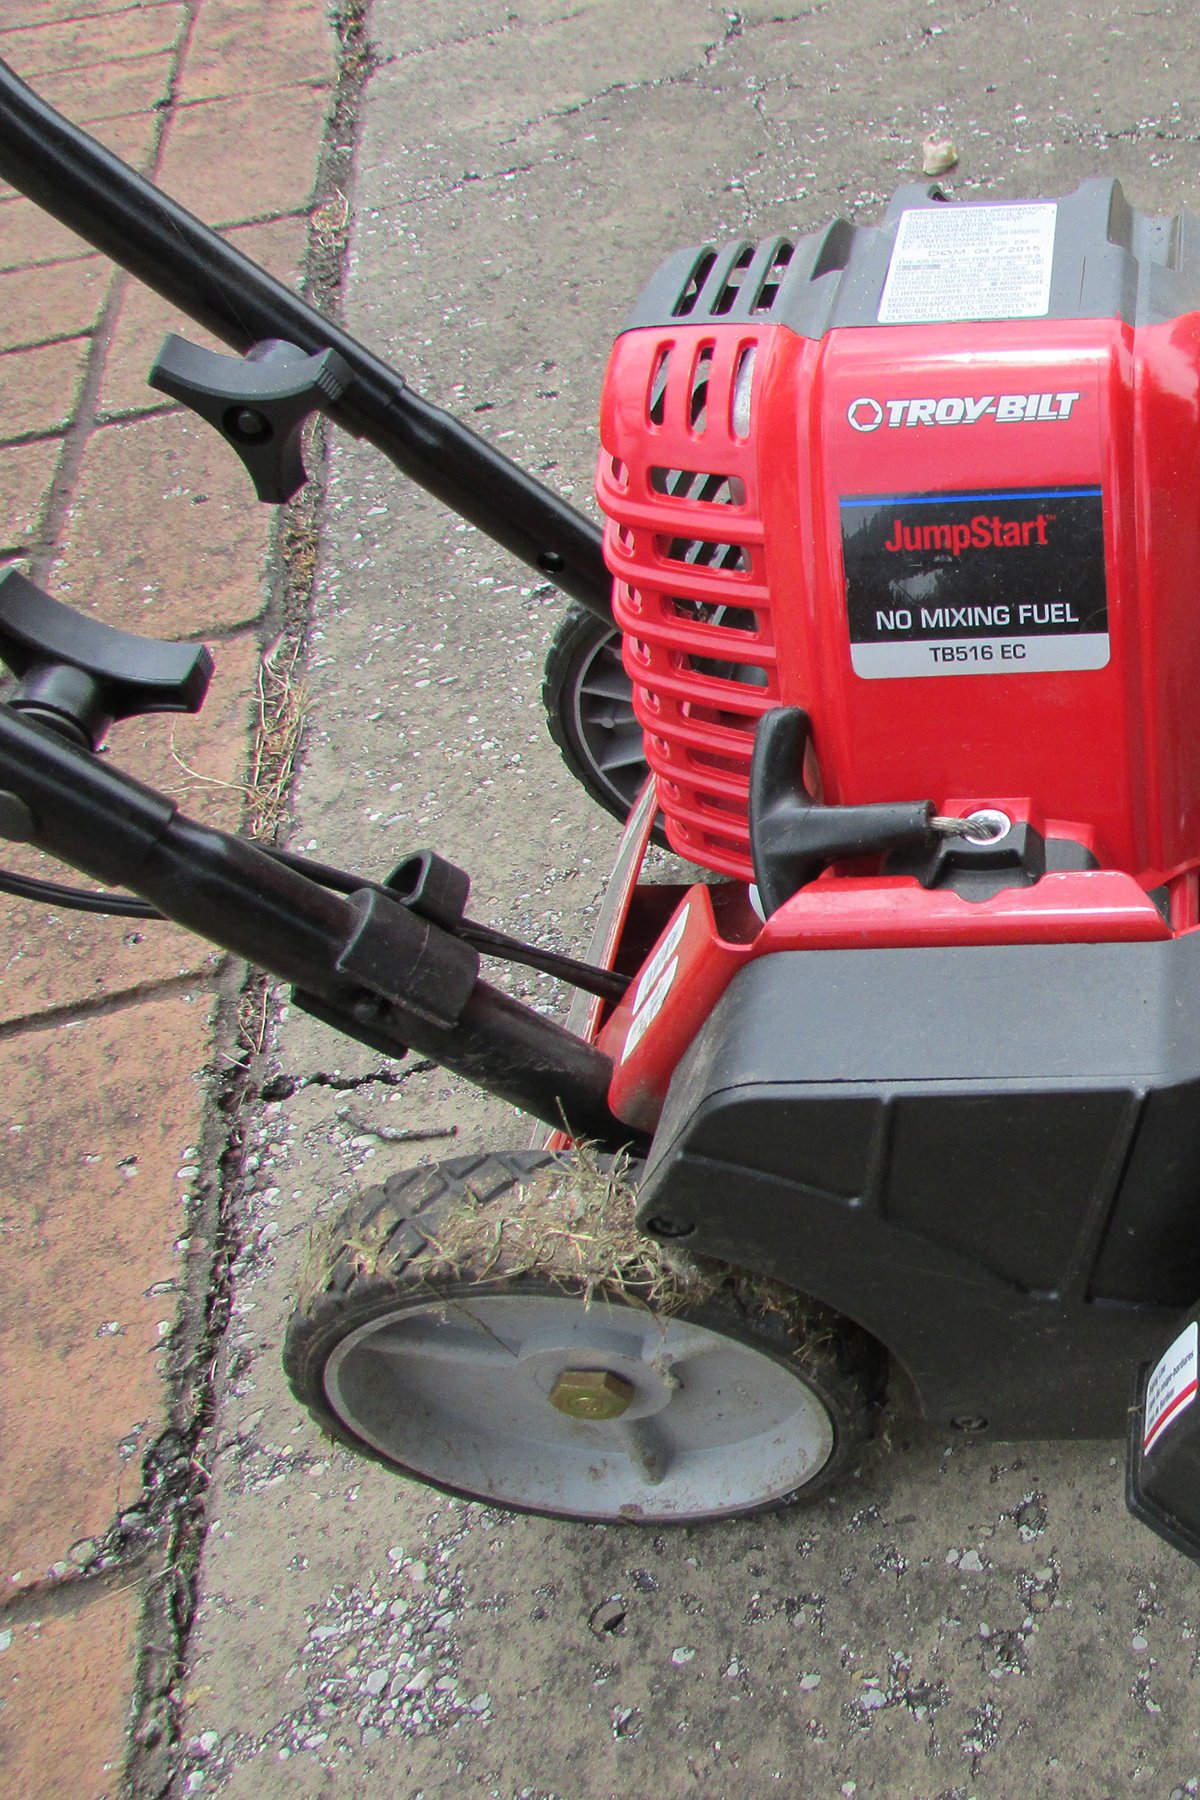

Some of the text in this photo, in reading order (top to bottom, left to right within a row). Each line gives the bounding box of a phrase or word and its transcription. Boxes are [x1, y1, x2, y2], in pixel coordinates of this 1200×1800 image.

[886, 392, 1080, 428] TROY-BILT
[884, 513, 1048, 556] JumpStart
[876, 603, 1079, 631] NO MIXING FUEL
[929, 643, 1026, 663] TB516 EC
